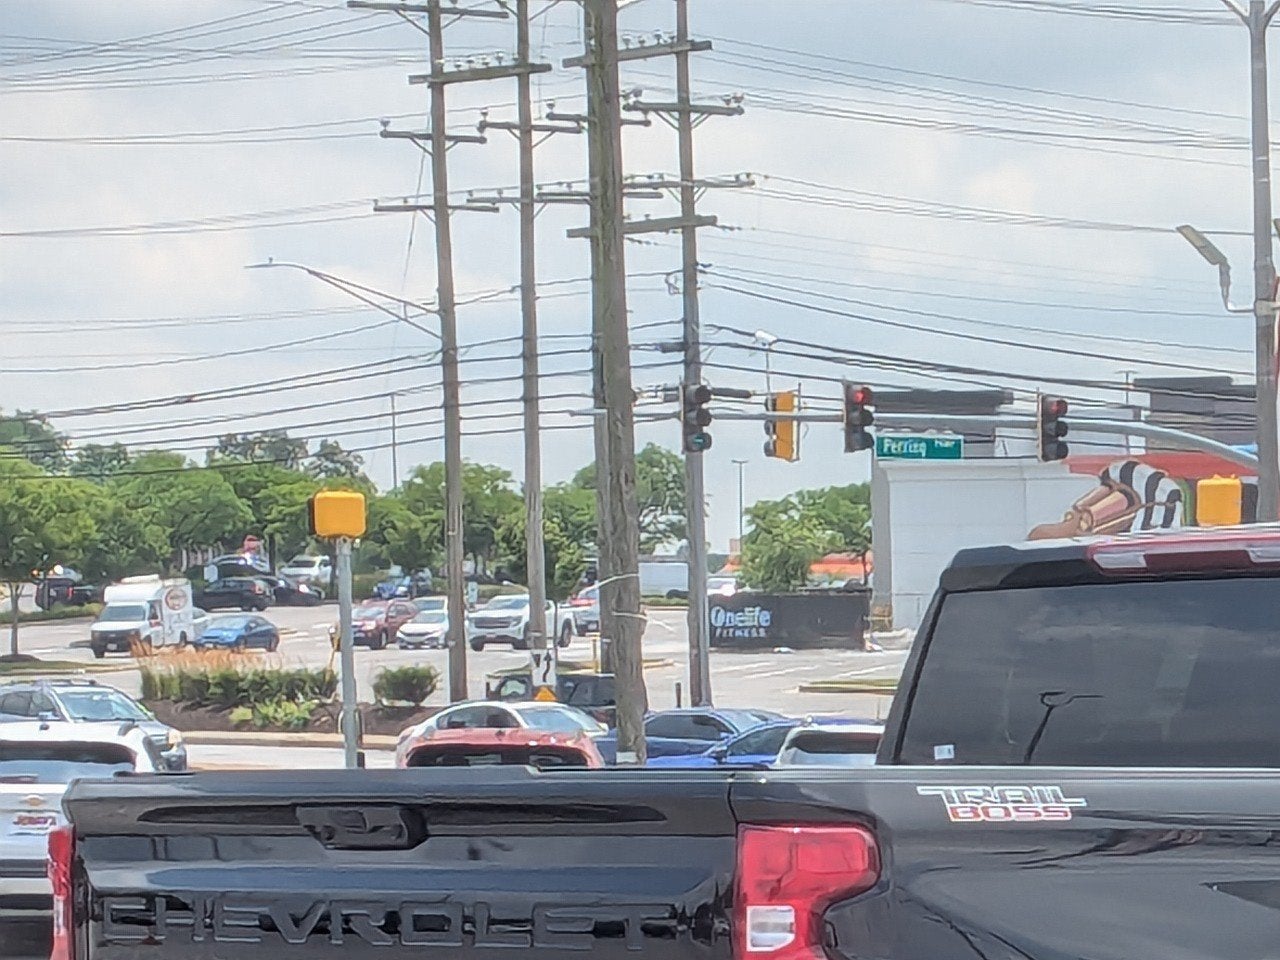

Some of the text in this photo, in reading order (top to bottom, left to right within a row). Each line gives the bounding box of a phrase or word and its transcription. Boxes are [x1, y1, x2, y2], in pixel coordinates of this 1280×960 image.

[883, 438, 927, 457] Perring
[916, 786, 1087, 806] TRAIL
[947, 804, 1073, 822] BOSS
[101, 896, 681, 951] CHEVROLET
